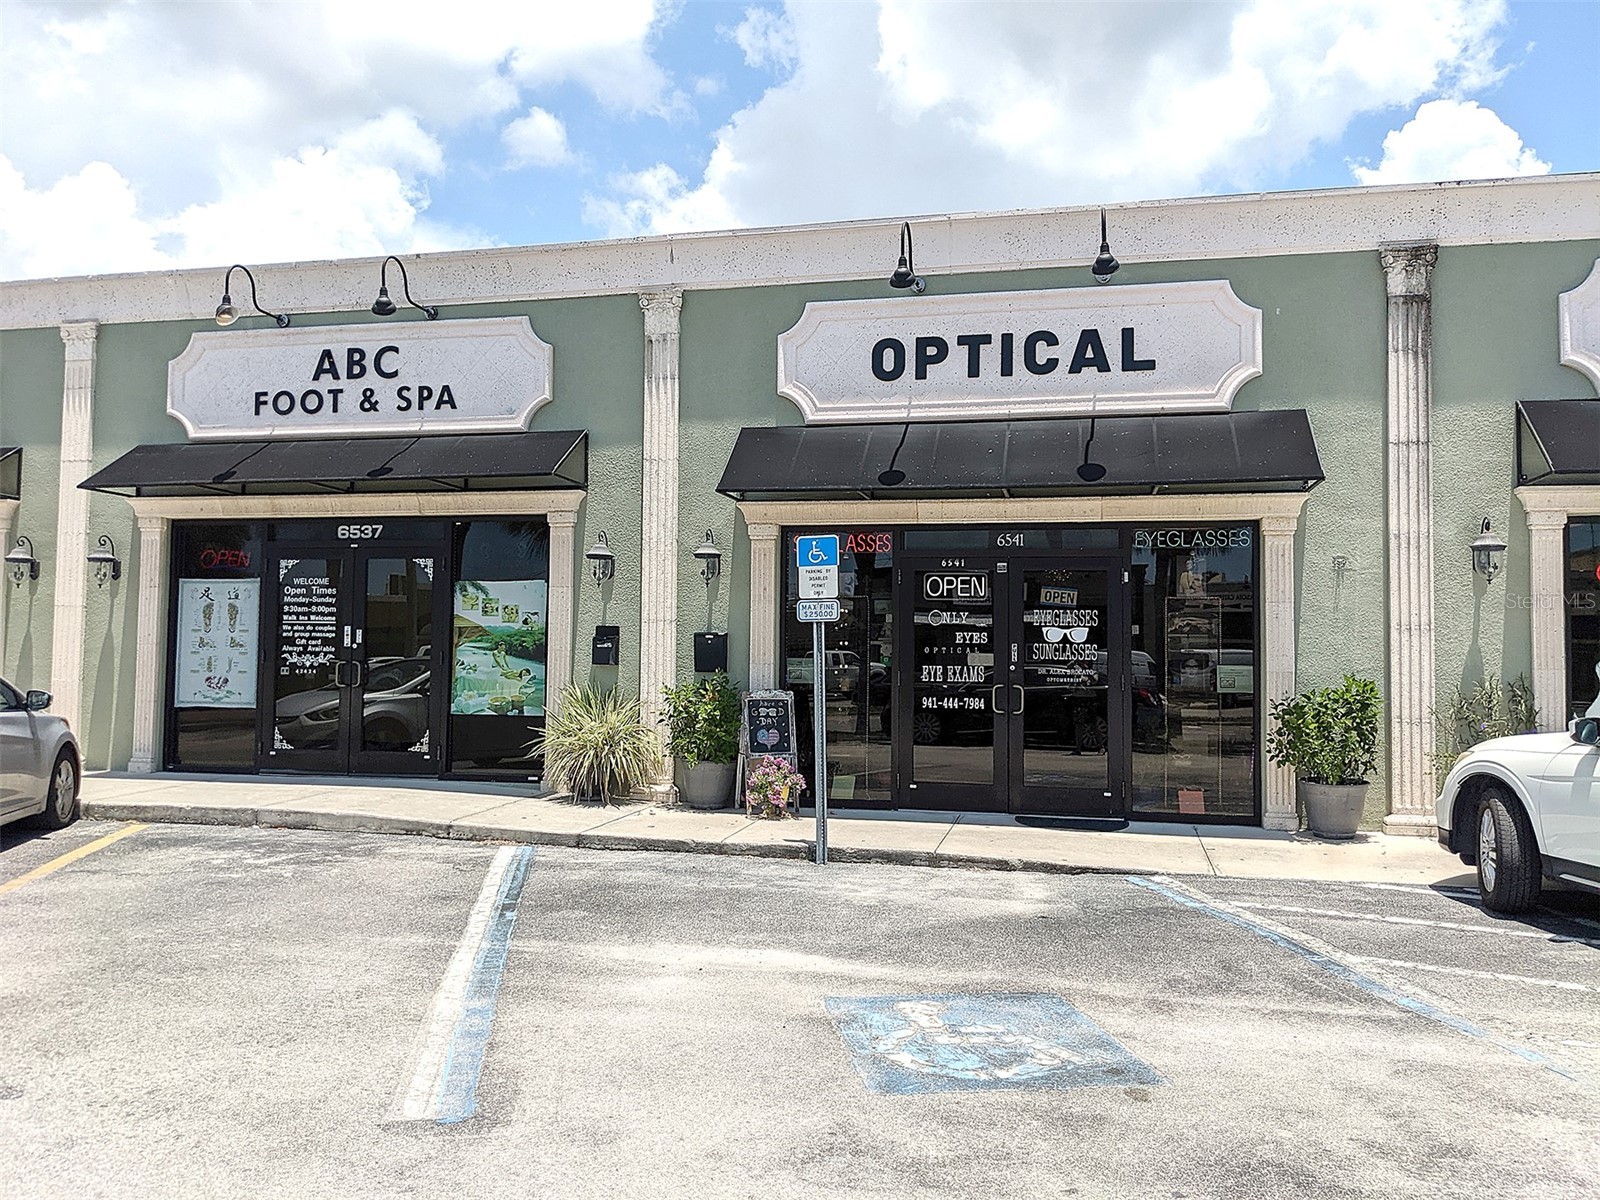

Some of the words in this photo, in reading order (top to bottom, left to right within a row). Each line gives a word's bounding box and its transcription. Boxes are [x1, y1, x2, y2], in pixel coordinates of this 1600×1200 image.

[871, 327, 1157, 382] OPTICAL
[312, 345, 400, 381] ABC
[254, 388, 344, 416] FOOT
[359, 390, 380, 413] &
[396, 384, 458, 412] SPA
[337, 524, 384, 539] 6537
[1135, 529, 1251, 548] EYEGLASSES
[996, 533, 1024, 547] 6541
[200, 549, 251, 569] OPEN
[941, 558, 965, 567] 6541
[293, 577, 330, 585] WELCOME
[926, 576, 985, 597] OPEN
[284, 586, 307, 596] Open
[311, 586, 337, 595] Times
[1044, 590, 1076, 604] OPEN
[283, 595, 337, 604] Monday-Sunday
[283, 605, 337, 614] 9:30am-9:00pm
[801, 603, 818, 611] MAX
[819, 603, 836, 611] FINE
[928, 609, 970, 626] ONLY
[1033, 609, 1099, 627] EYEGLASSES
[315, 624, 336, 632] couples
[955, 632, 988, 644] EYES
[281, 645, 304, 653] Always
[924, 646, 980, 654] OPTICAL
[1032, 643, 1098, 661] SUNGLASSES
[921, 665, 943, 682] EYE
[947, 665, 985, 682] EXAMS
[922, 697, 985, 710] 941-444-7984
[759, 717, 779, 726] DAY
